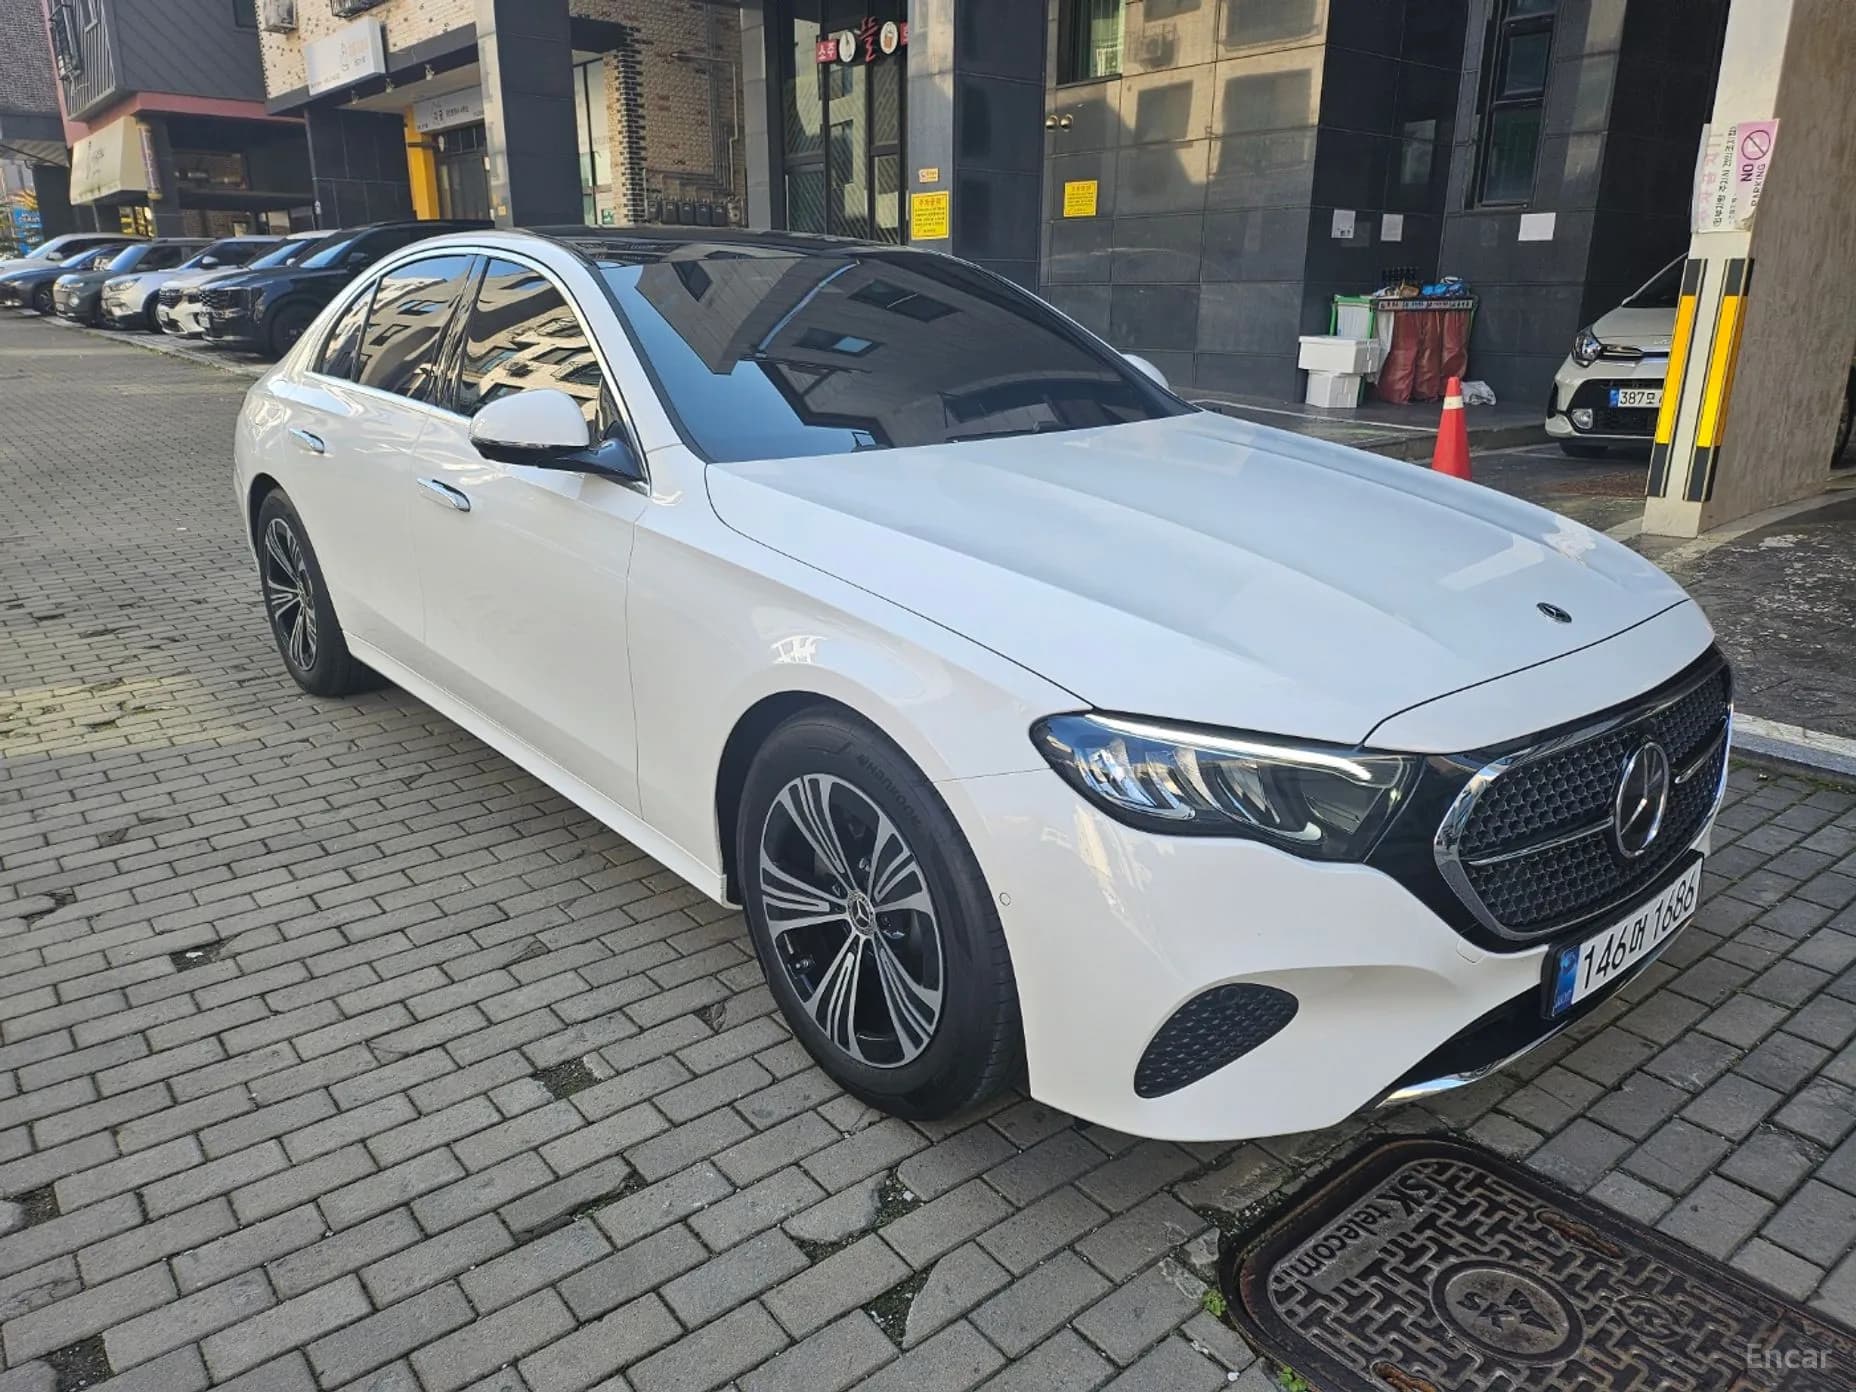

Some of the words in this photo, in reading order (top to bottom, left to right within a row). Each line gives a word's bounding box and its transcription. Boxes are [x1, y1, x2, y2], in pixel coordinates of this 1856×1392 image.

[818, 42, 836, 61] 소주
[1740, 163, 1754, 182] NO
[1751, 163, 1765, 207] PARKING
[1584, 912, 1648, 990] 146머
[1653, 870, 1696, 941] 1686
[1375, 1173, 1438, 1218] SK
[1290, 1203, 1392, 1278] telecom
[1456, 1291, 1514, 1332] SK
